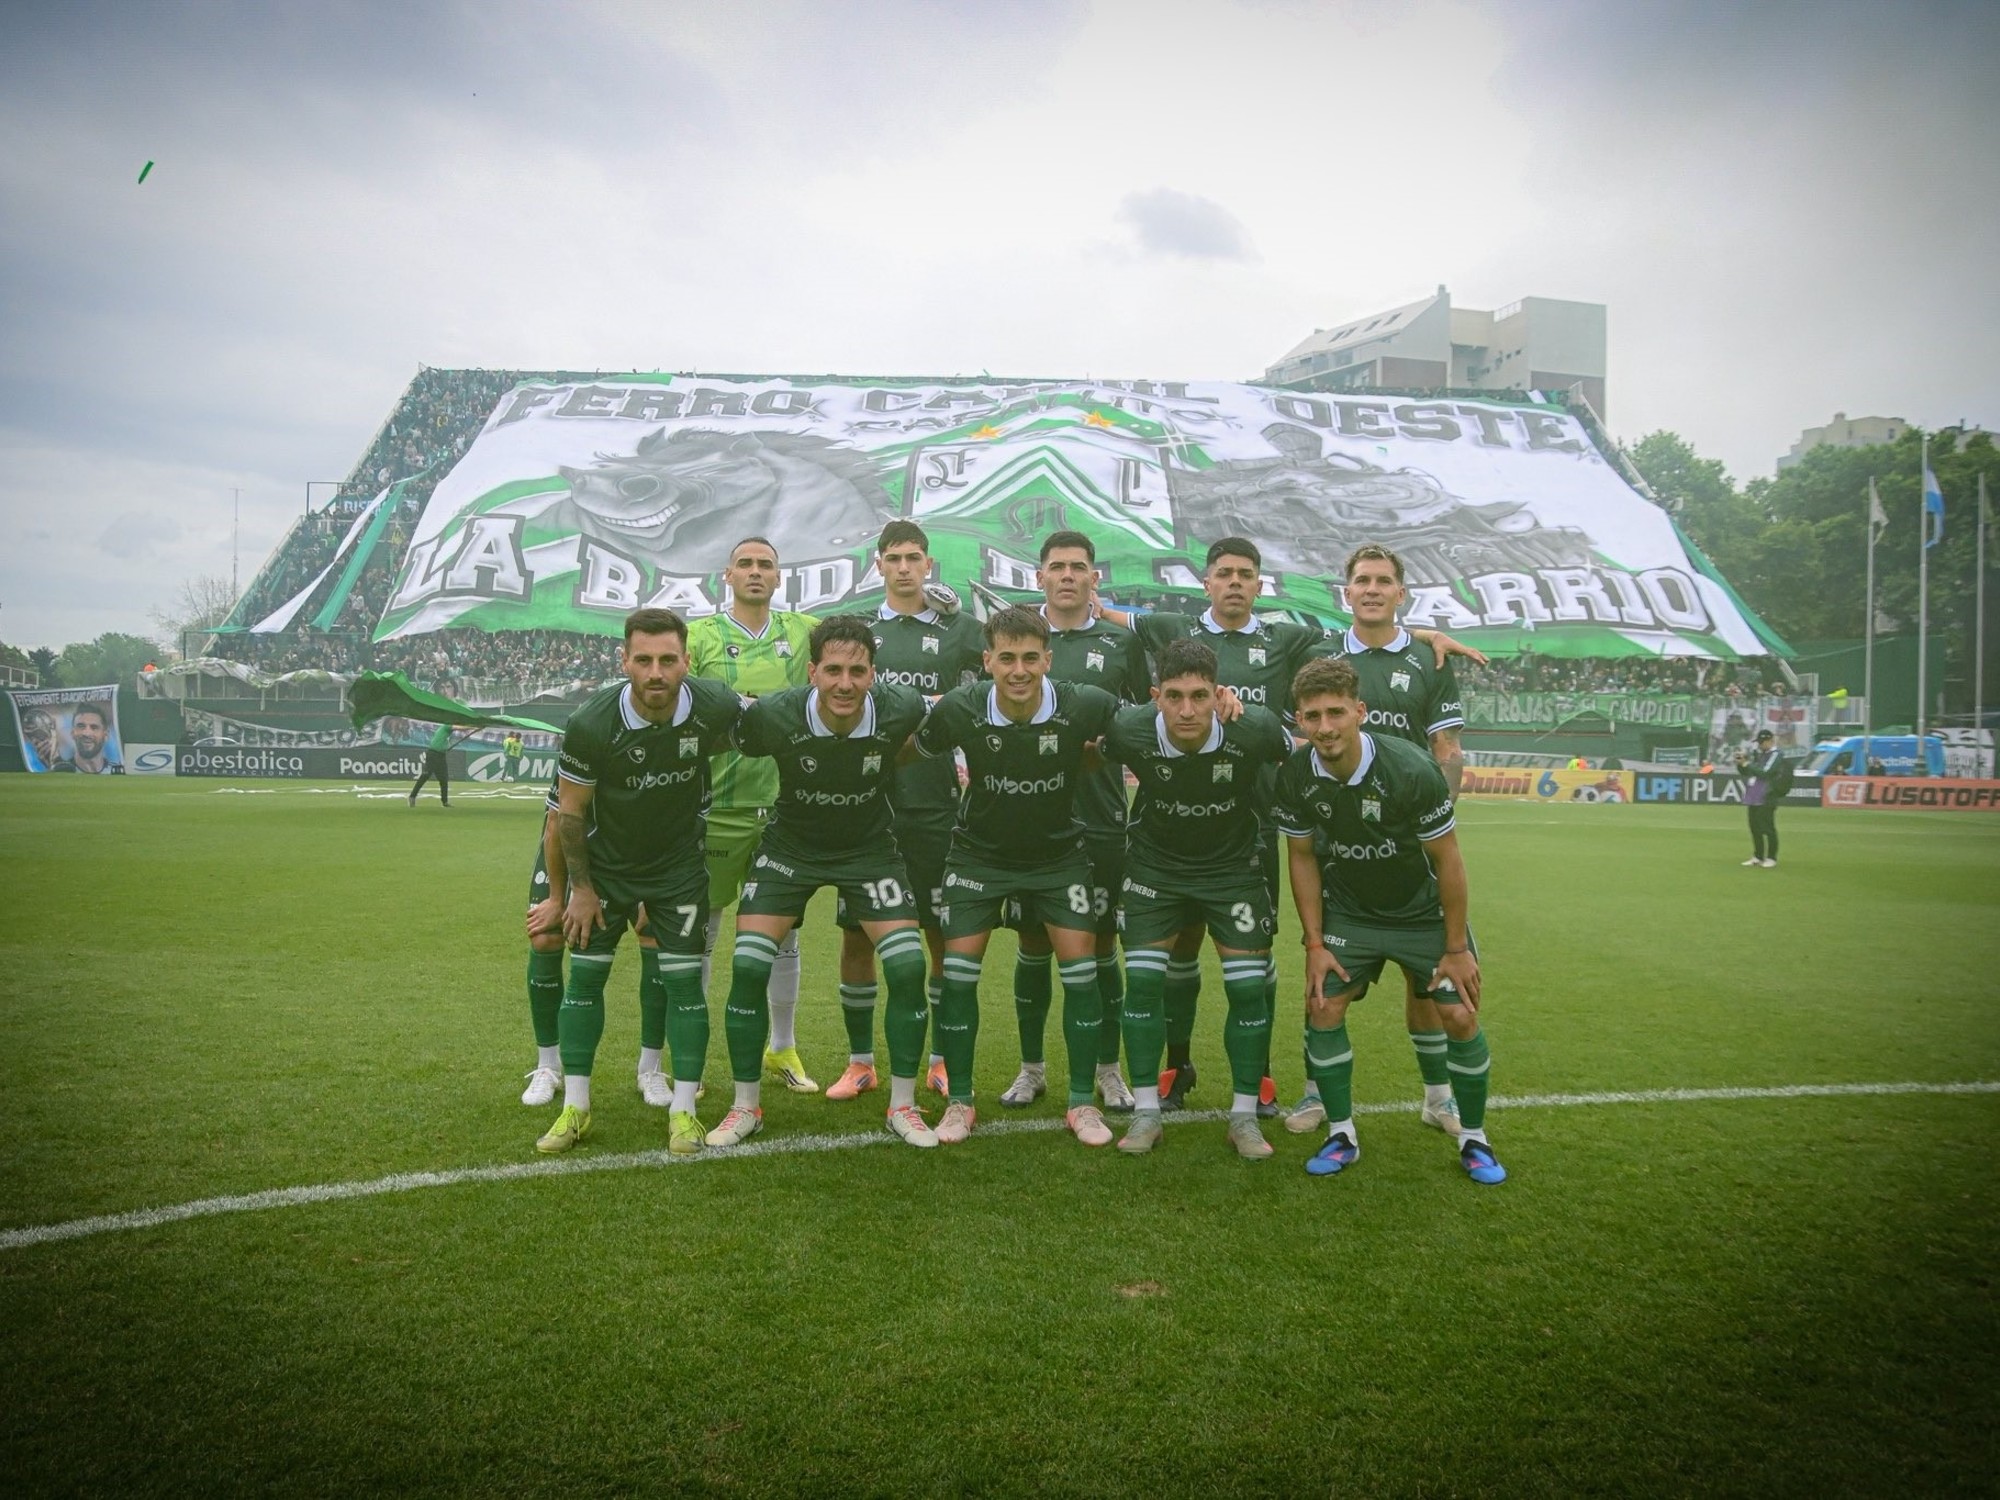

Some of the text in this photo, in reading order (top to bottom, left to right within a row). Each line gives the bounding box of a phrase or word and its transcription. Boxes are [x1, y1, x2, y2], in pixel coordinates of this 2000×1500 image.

[497, 386, 814, 426] FERRO
[1273, 396, 1584, 450] OESTE
[388, 516, 528, 610] LA
[1497, 695, 1554, 723] ROJAS
[181, 749, 303, 772] pbestatica
[340, 757, 423, 778] Panacity
[625, 766, 697, 790] flybondi
[984, 771, 1065, 794] flybondi
[1537, 770, 1560, 797] 6
[1638, 778, 1682, 801] LPF
[767, 860, 795, 878] ONEBOX
[861, 877, 903, 910] 10
[956, 877, 985, 892] ONEBOX
[1130, 882, 1158, 899] ONEBOX
[1067, 884, 1091, 915] 8
[676, 904, 699, 937] 7
[1231, 902, 1256, 933] 3
[728, 1004, 756, 1015] LYON
[1125, 1010, 1151, 1019] LYON
[940, 1023, 968, 1031] LYON
[1239, 1018, 1267, 1027] LYON
